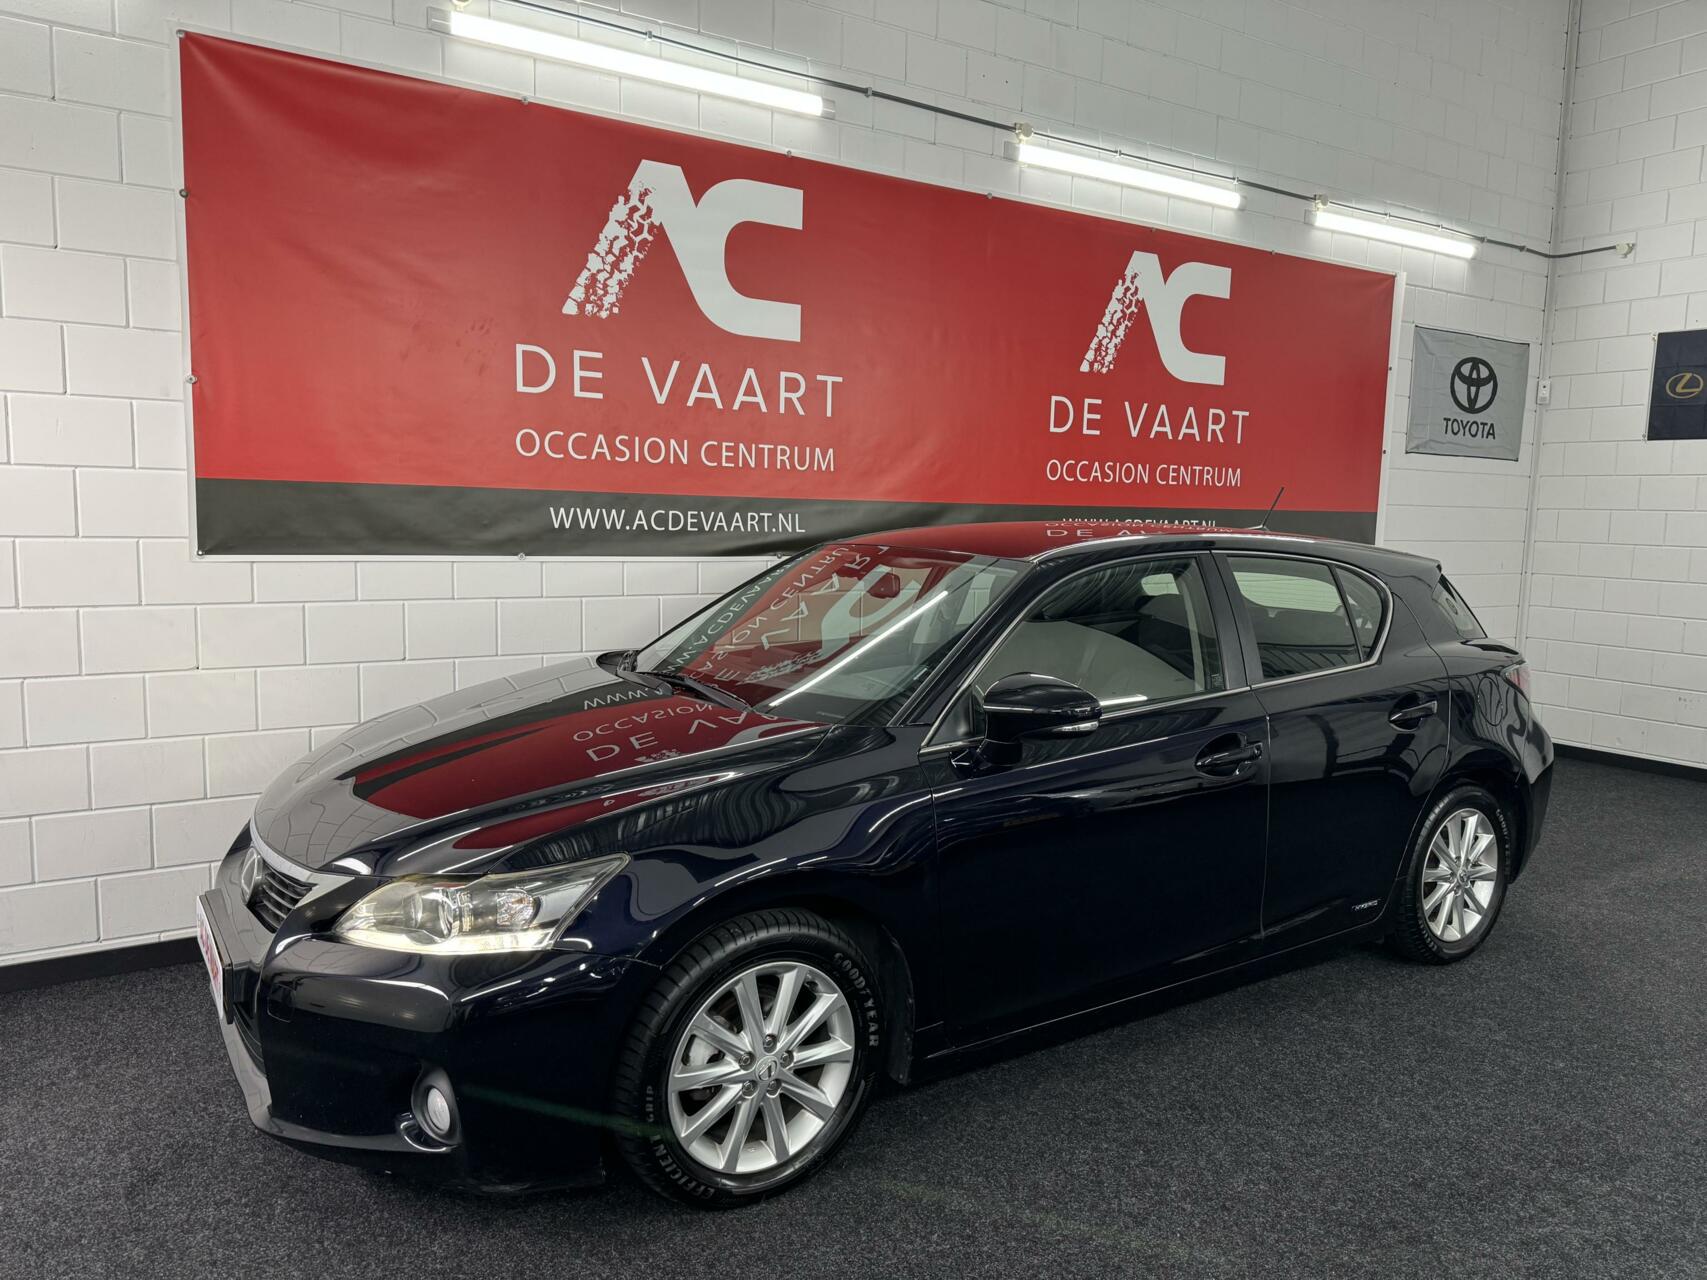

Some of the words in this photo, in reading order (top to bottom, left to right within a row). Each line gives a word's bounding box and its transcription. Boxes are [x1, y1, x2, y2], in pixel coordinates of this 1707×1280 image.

[515, 343, 604, 400] DE
[641, 356, 843, 417] VAART
[1049, 395, 1103, 436] DE
[1124, 401, 1250, 444] VAART
[1443, 417, 1496, 440] TOYOTA
[515, 428, 688, 465] OCCASION
[700, 440, 836, 472] CENTRUM
[1046, 459, 1149, 484] OCCASION
[1156, 464, 1241, 487] CENTRUM
[549, 506, 806, 533] WWW.ACDEVAART.NL
